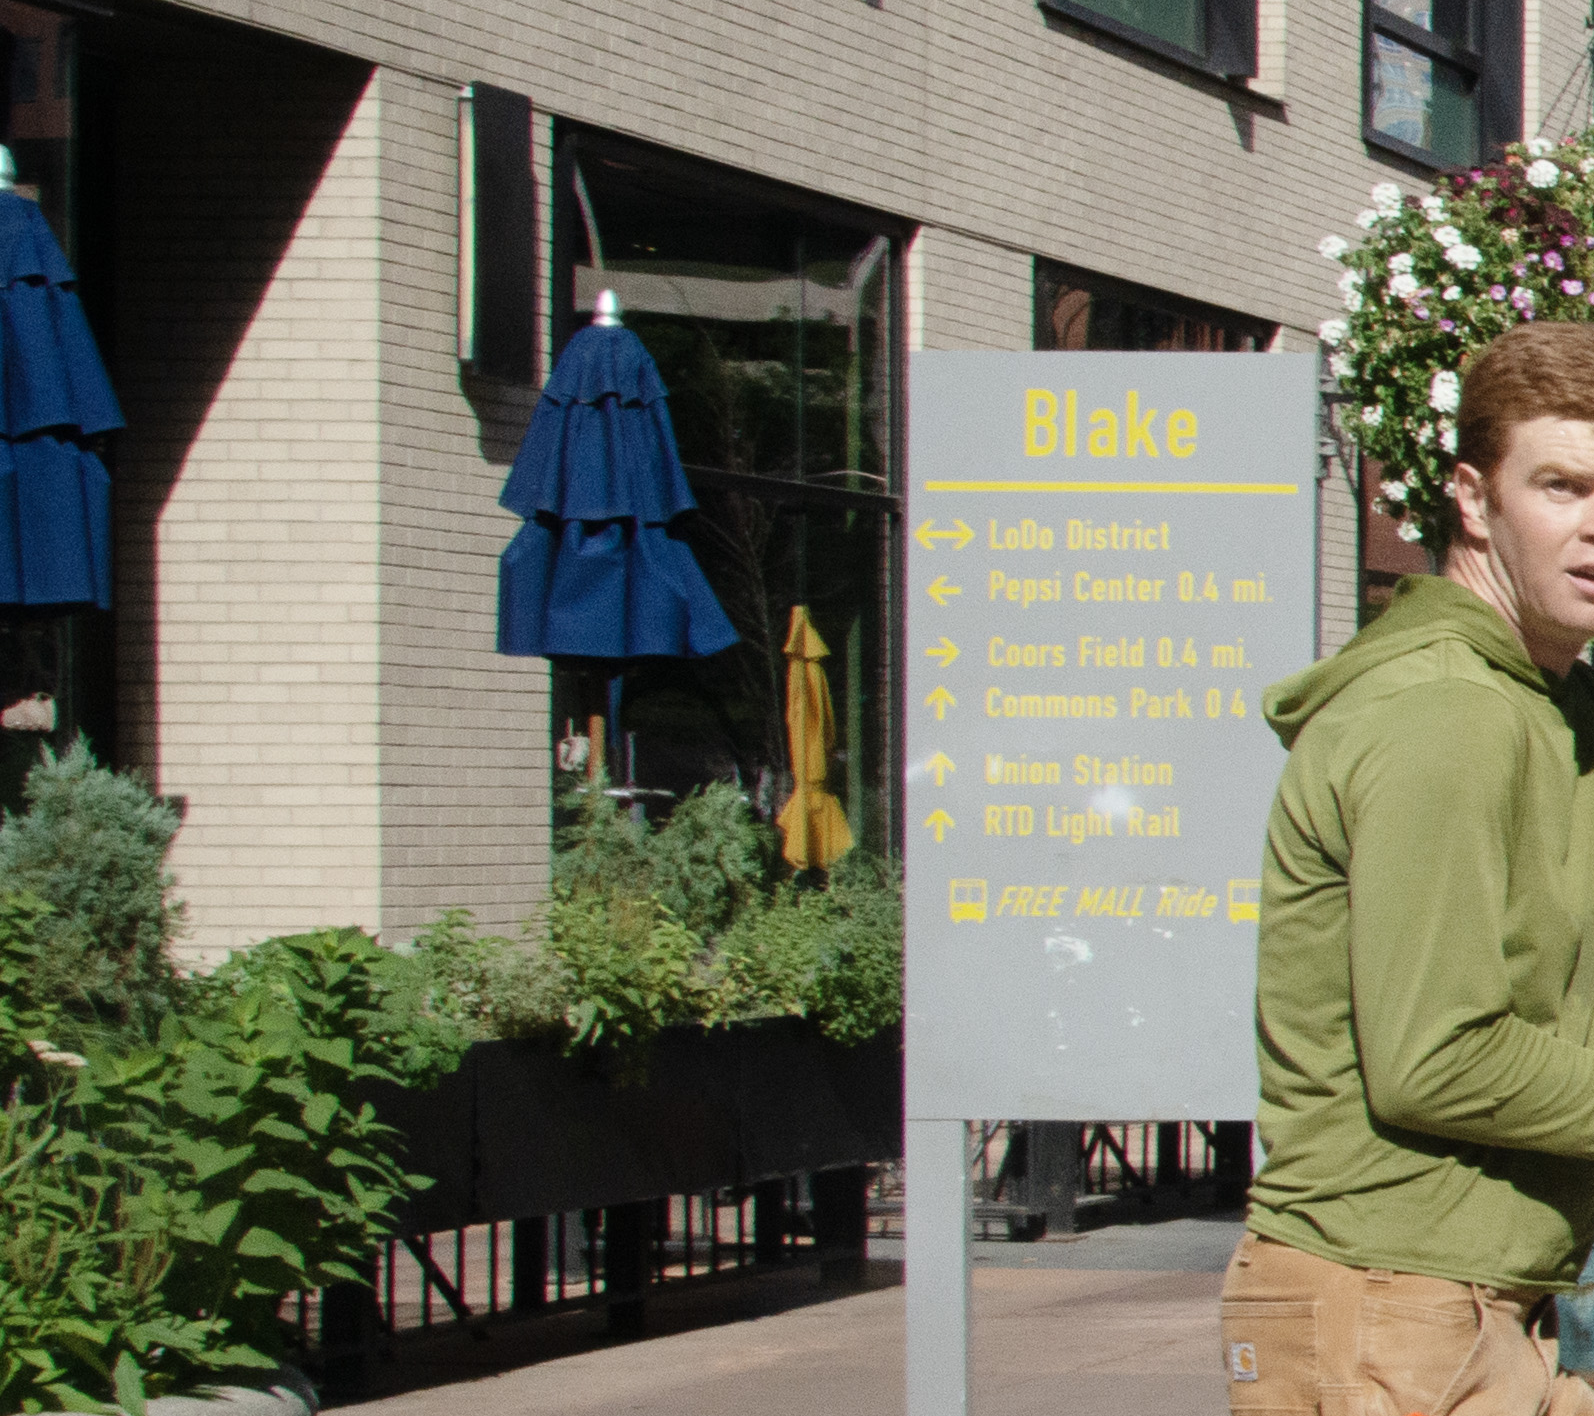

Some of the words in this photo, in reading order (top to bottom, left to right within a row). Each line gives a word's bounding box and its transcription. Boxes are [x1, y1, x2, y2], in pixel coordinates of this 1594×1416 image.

[1024, 388, 1198, 458] Blake
[988, 519, 1053, 550] LoDo
[1066, 519, 1170, 550] District
[988, 570, 1062, 609] Pepsi
[1074, 571, 1165, 602] Center
[1178, 571, 1219, 602] 0.4
[1232, 571, 1274, 602] mi.
[988, 636, 1066, 668] Coors
[1077, 636, 1145, 668] Field
[1157, 636, 1198, 668] 0.4
[1211, 637, 1253, 668] mi.
[985, 687, 1118, 719] Commons
[1130, 687, 1192, 719] Park
[985, 754, 1061, 785] Union
[1073, 754, 1173, 785] Station
[984, 805, 1034, 836] RTD
[1047, 805, 1113, 845] Light
[1127, 805, 1180, 837] Rail
[995, 885, 1069, 917] FREE
[1074, 885, 1146, 917] MALL
[1156, 885, 1219, 917] Ride
